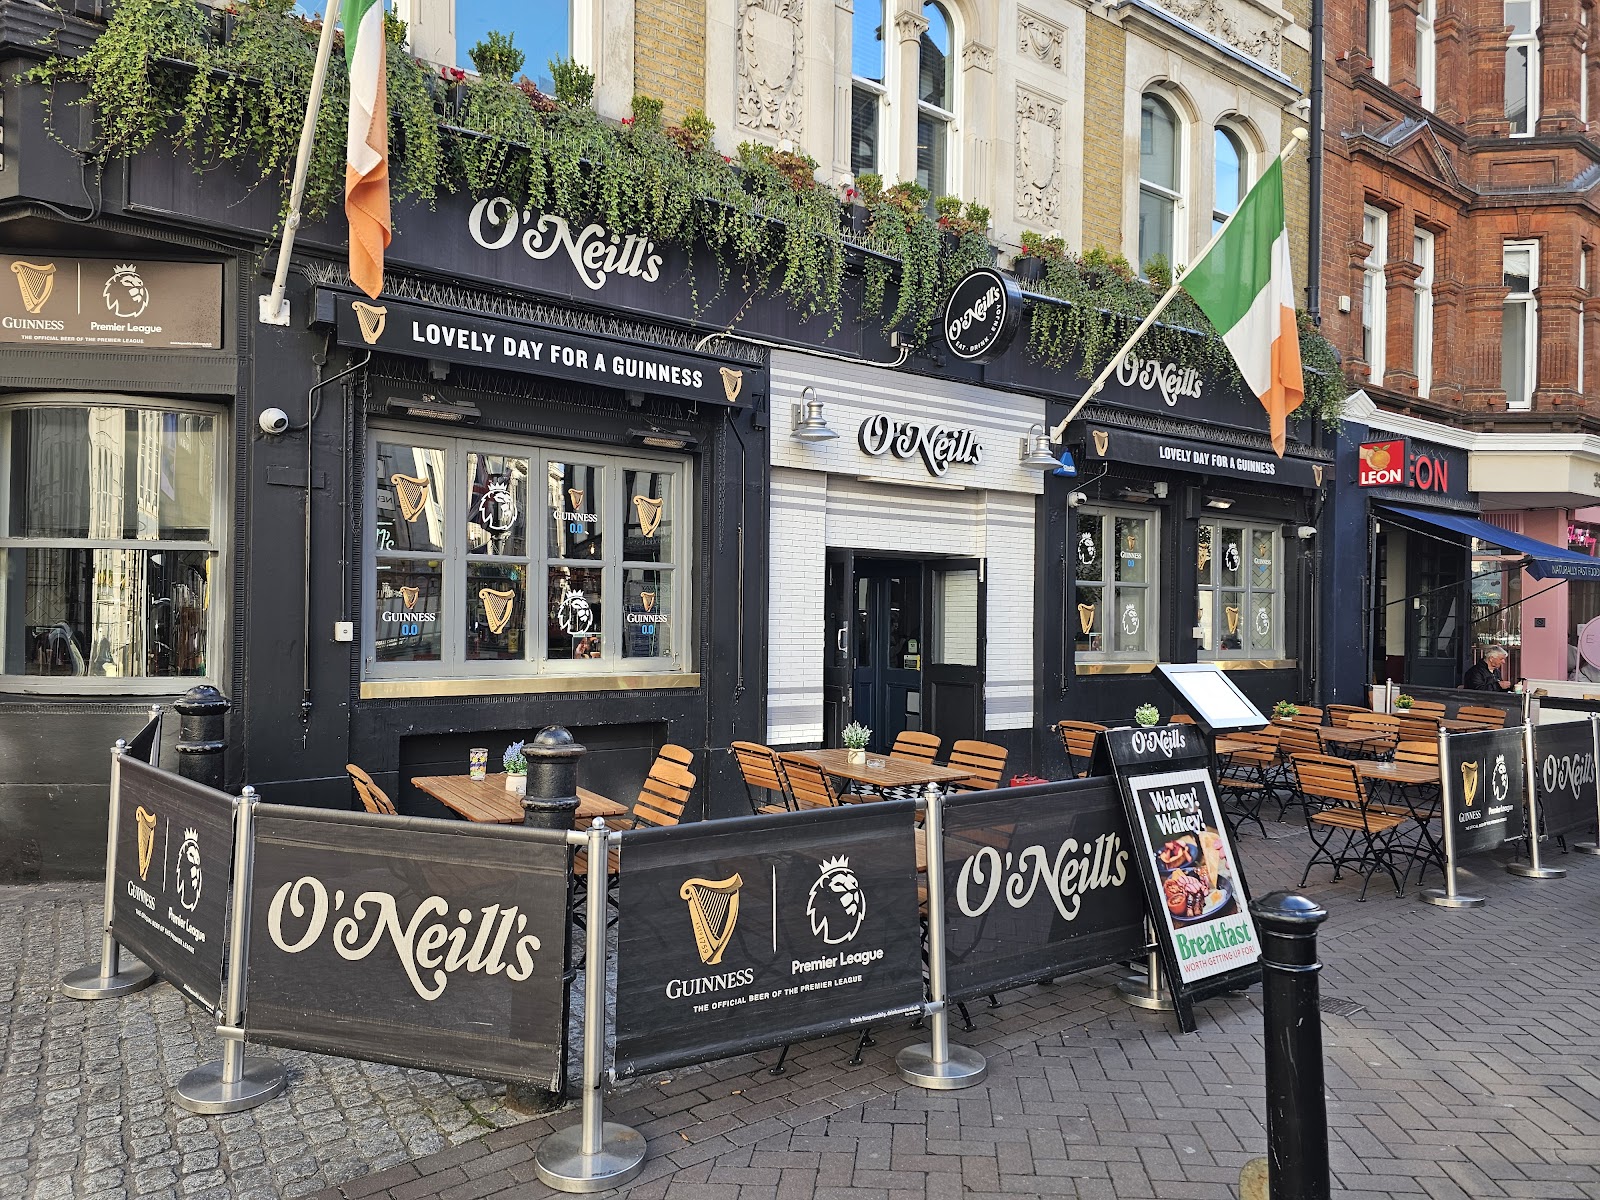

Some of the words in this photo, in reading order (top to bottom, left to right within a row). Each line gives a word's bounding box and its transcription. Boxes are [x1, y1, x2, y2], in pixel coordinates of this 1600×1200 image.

[468, 196, 663, 290] O'Neill's
[2, 316, 65, 331] GUINNESS
[90, 321, 125, 331] Premier
[127, 323, 162, 334] League
[949, 287, 1000, 340] O'Neill's
[955, 340, 966, 351] EAT
[969, 336, 990, 352] DRINK
[991, 304, 1002, 332] ENJOY
[412, 320, 496, 354] LOVELY
[503, 335, 544, 361] DAY
[550, 342, 588, 370] FOR
[594, 352, 606, 372] A
[612, 356, 703, 389] GUINNESS
[1116, 351, 1203, 407] O'Neill's
[859, 413, 983, 477] O'Neill's
[1159, 446, 1191, 463] LOVELY
[1193, 451, 1210, 465] DAY
[1211, 454, 1229, 468] FOR
[1229, 457, 1236, 469] A
[1236, 458, 1276, 475] GUINNESS
[1361, 468, 1402, 485] LEON
[553, 510, 598, 523] GUINNESS
[569, 523, 583, 534] 0.0
[382, 611, 436, 622] GUINNESS
[401, 624, 418, 636] 0.0
[627, 613, 668, 623] GUINNESS
[641, 624, 655, 635] 0.0
[1149, 786, 1200, 813] Wakey!
[1155, 808, 1207, 836] Wakey!
[956, 831, 1129, 921] O'Neill's
[127, 880, 156, 911] GUINNESS
[186, 918, 206, 942] League
[267, 876, 541, 1001] O'Neill's
[1175, 919, 1252, 961] Breakfast
[792, 956, 838, 975] Premier
[840, 948, 885, 965] League
[1184, 960, 1207, 973] WORTH
[1208, 951, 1233, 966] GETTING
[1232, 949, 1242, 959] UP
[1241, 945, 1256, 956] FOR!
[665, 967, 754, 1000] GUINNESS
[693, 1004, 709, 1013] THE
[711, 998, 747, 1010] OFFICIAL
[748, 992, 770, 1002] BEER
[771, 990, 783, 998] OF
[784, 987, 799, 996] THE
[800, 980, 833, 993] PREMIER
[834, 975, 863, 986] LEAGUE
